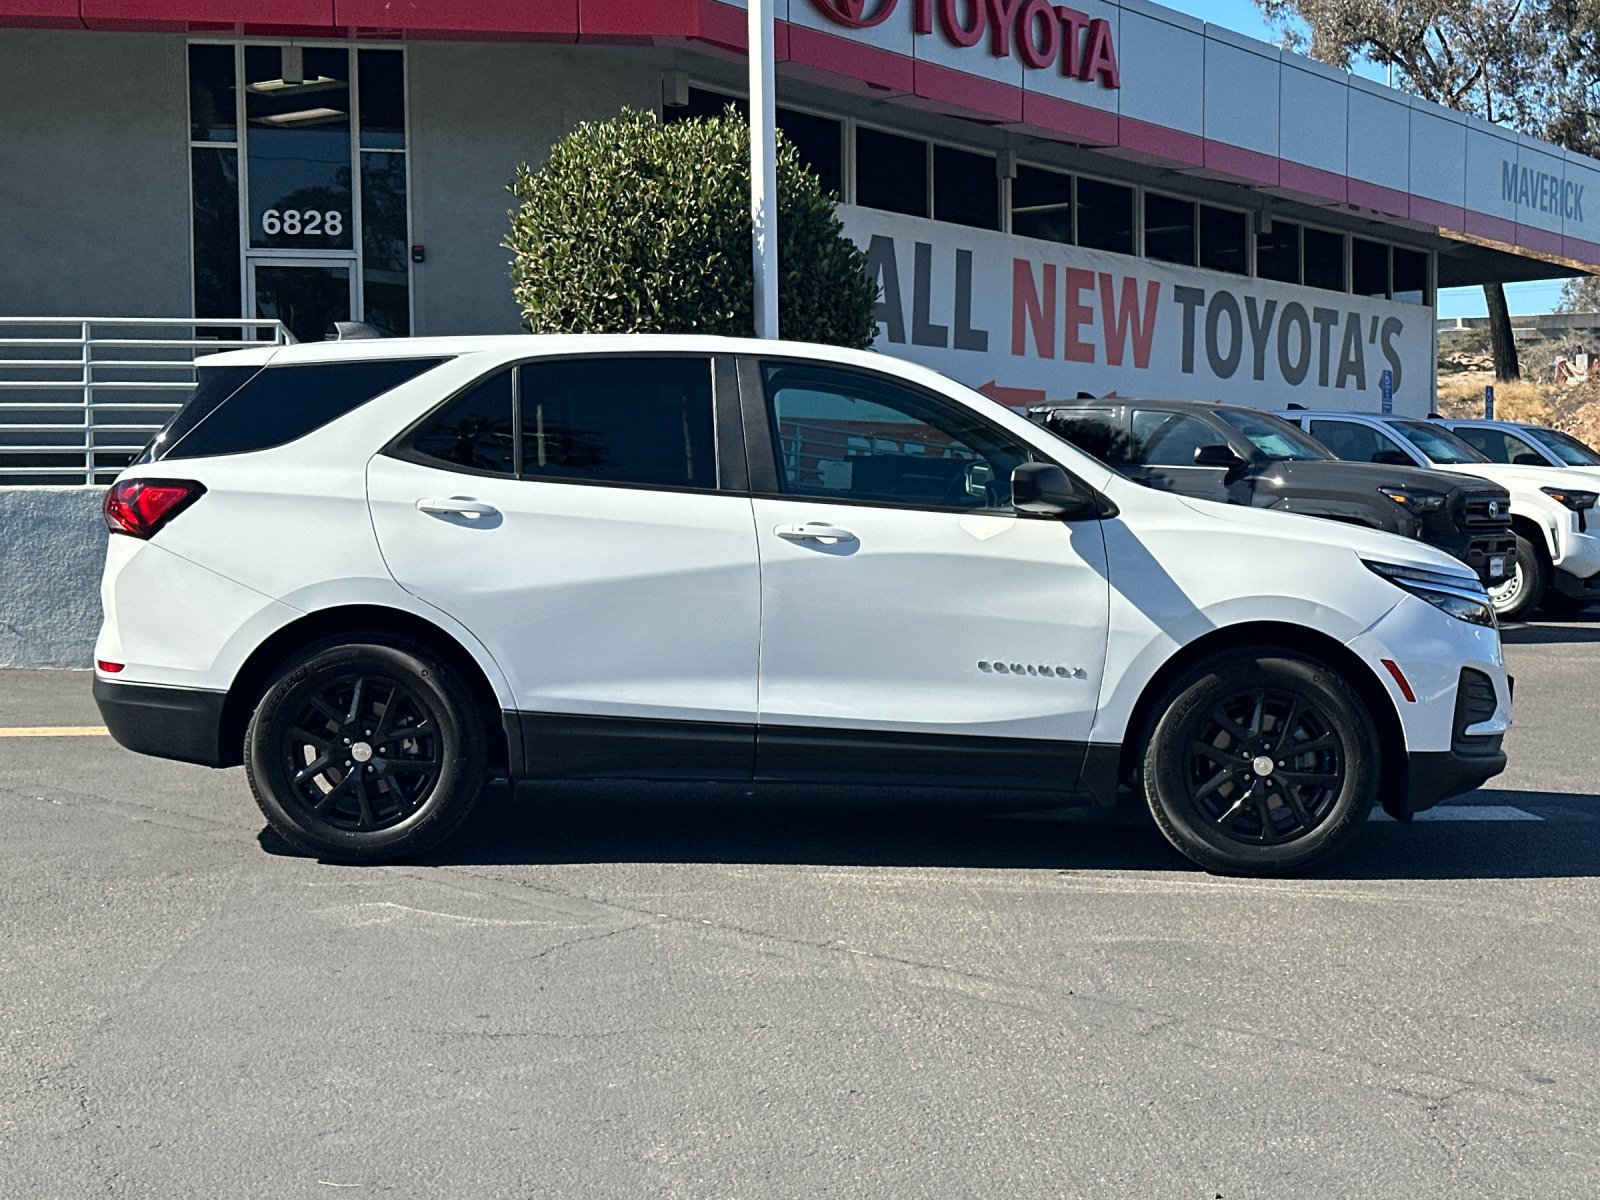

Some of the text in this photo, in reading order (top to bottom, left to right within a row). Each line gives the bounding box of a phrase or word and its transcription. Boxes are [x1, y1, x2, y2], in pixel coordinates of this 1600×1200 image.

[1502, 160, 1584, 222] MAVERICK
[262, 209, 343, 236] 6828
[865, 233, 1404, 394] ALL NEW TOYOTA'S
[977, 660, 1088, 680] EQUINOX
